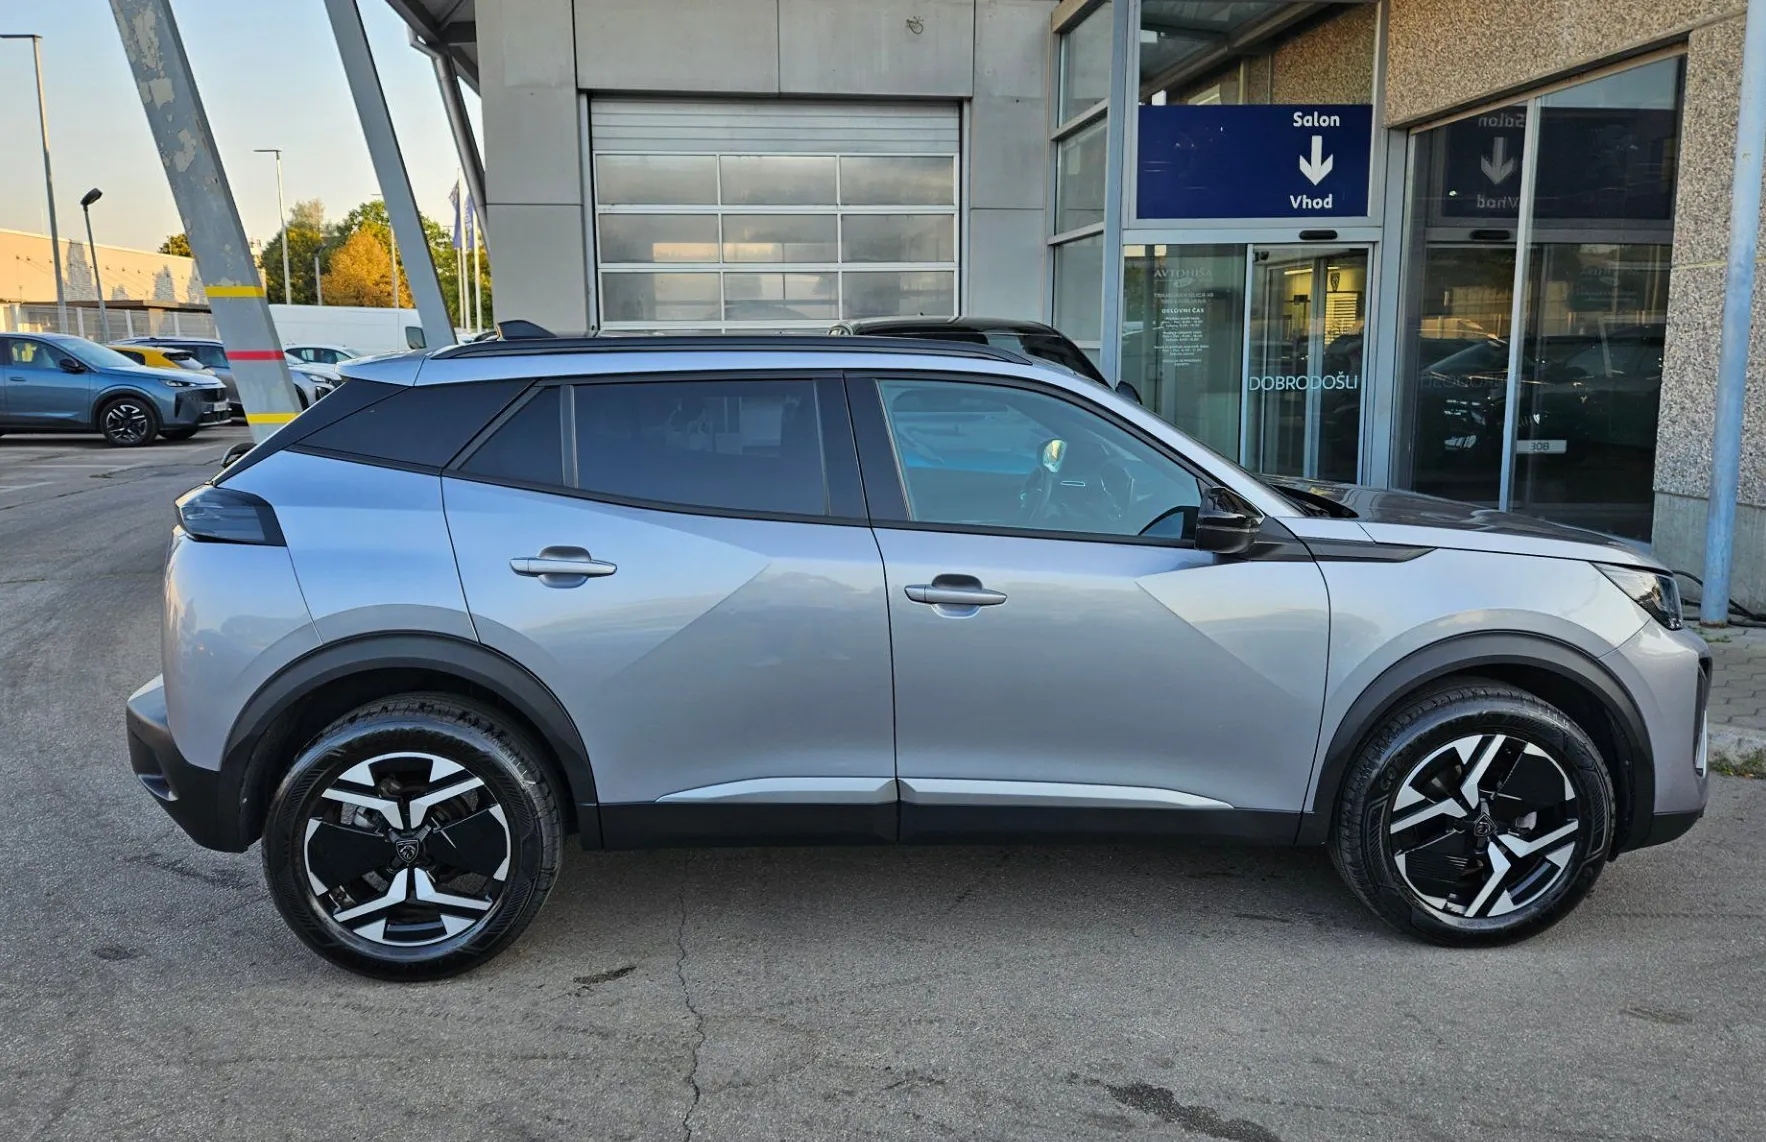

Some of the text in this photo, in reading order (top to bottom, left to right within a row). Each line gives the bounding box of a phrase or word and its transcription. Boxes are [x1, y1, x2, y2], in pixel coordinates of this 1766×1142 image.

[1293, 111, 1340, 127] Salon
[1289, 193, 1333, 209] Vhod
[1248, 371, 1358, 391] DOBRODOŠLI
